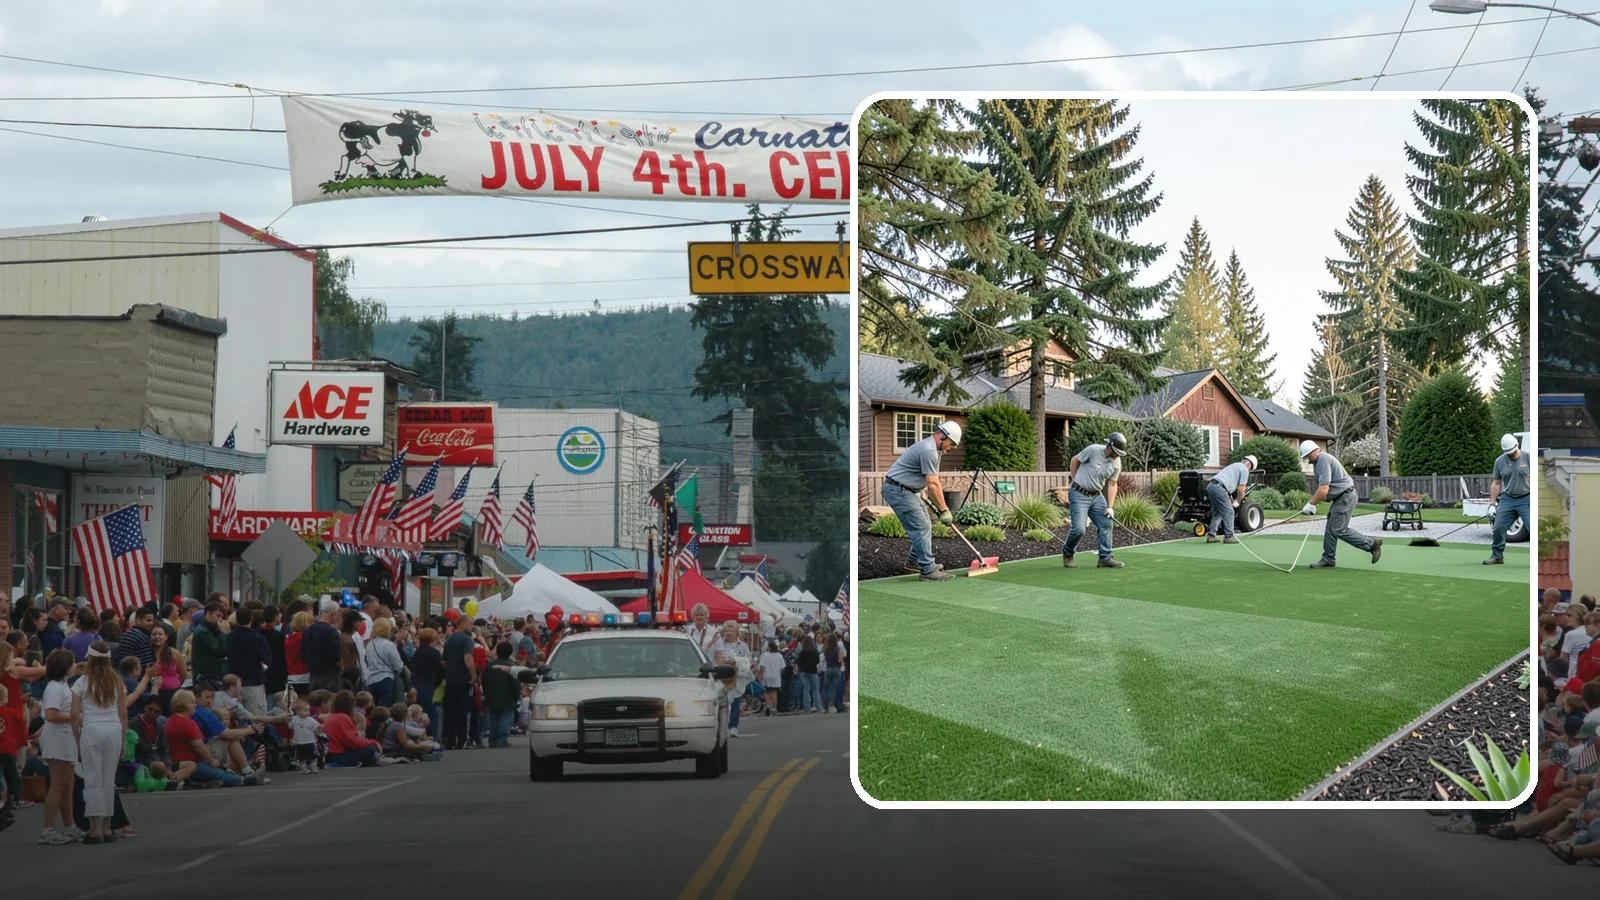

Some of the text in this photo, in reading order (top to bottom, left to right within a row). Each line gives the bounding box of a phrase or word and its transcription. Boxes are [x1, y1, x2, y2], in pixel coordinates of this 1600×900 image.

[481, 140, 605, 193] JULY
[632, 150, 746, 198] 4th.
[697, 254, 850, 280] CROSSWA
[282, 380, 374, 420] ACE
[405, 409, 453, 422] CEDAR
[283, 420, 371, 437] Hardware
[416, 427, 477, 447] Coca-Cola
[353, 467, 386, 481] Simpl
[83, 484, 155, 496] St. Vincent de Paul
[688, 526, 742, 535] CRNATION
